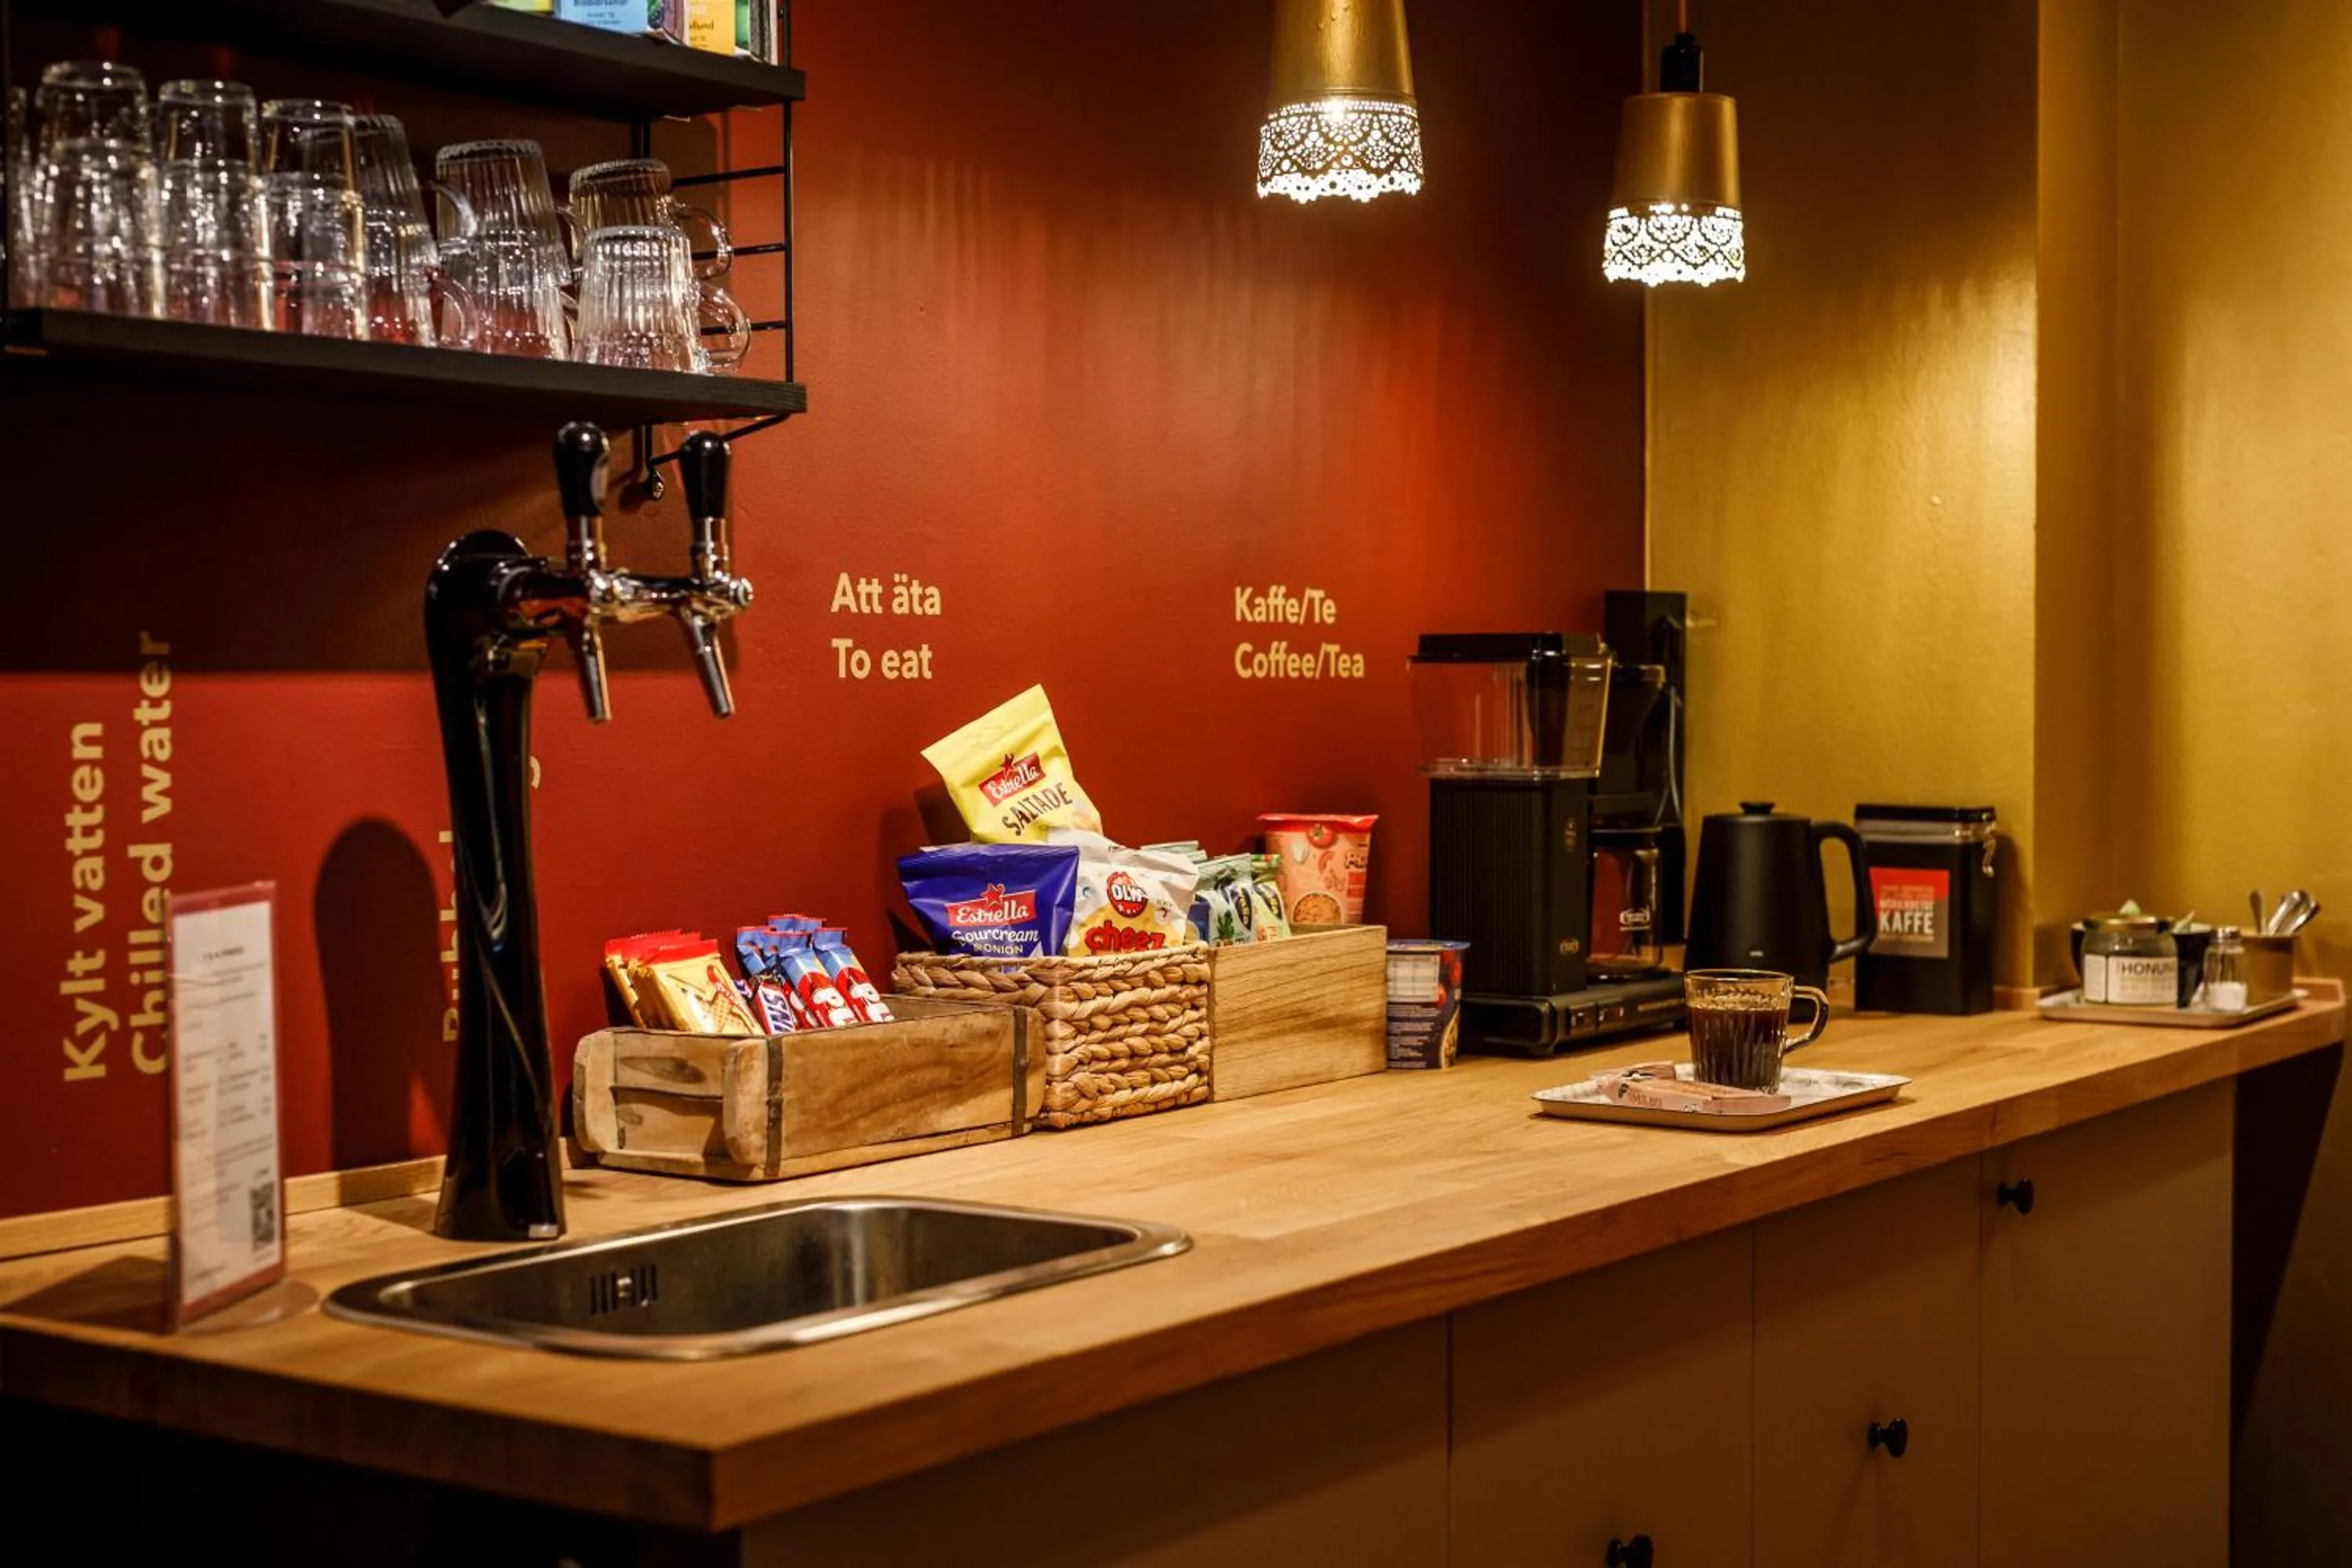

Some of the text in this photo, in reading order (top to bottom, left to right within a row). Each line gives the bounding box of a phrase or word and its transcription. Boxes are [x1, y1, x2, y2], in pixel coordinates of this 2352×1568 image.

[831, 572, 942, 615] Att äta
[1235, 586, 1338, 625] Kaffe/Te
[831, 637, 933, 681] To eat
[1235, 641, 1365, 679] Coffee/Tea
[133, 631, 173, 824] water
[986, 763, 1040, 799] Estrella
[1001, 782, 1073, 836] SALTADE
[60, 722, 119, 1082] Kylt vatten
[956, 899, 1029, 924] Estrella
[1879, 909, 1934, 934] KAFFE
